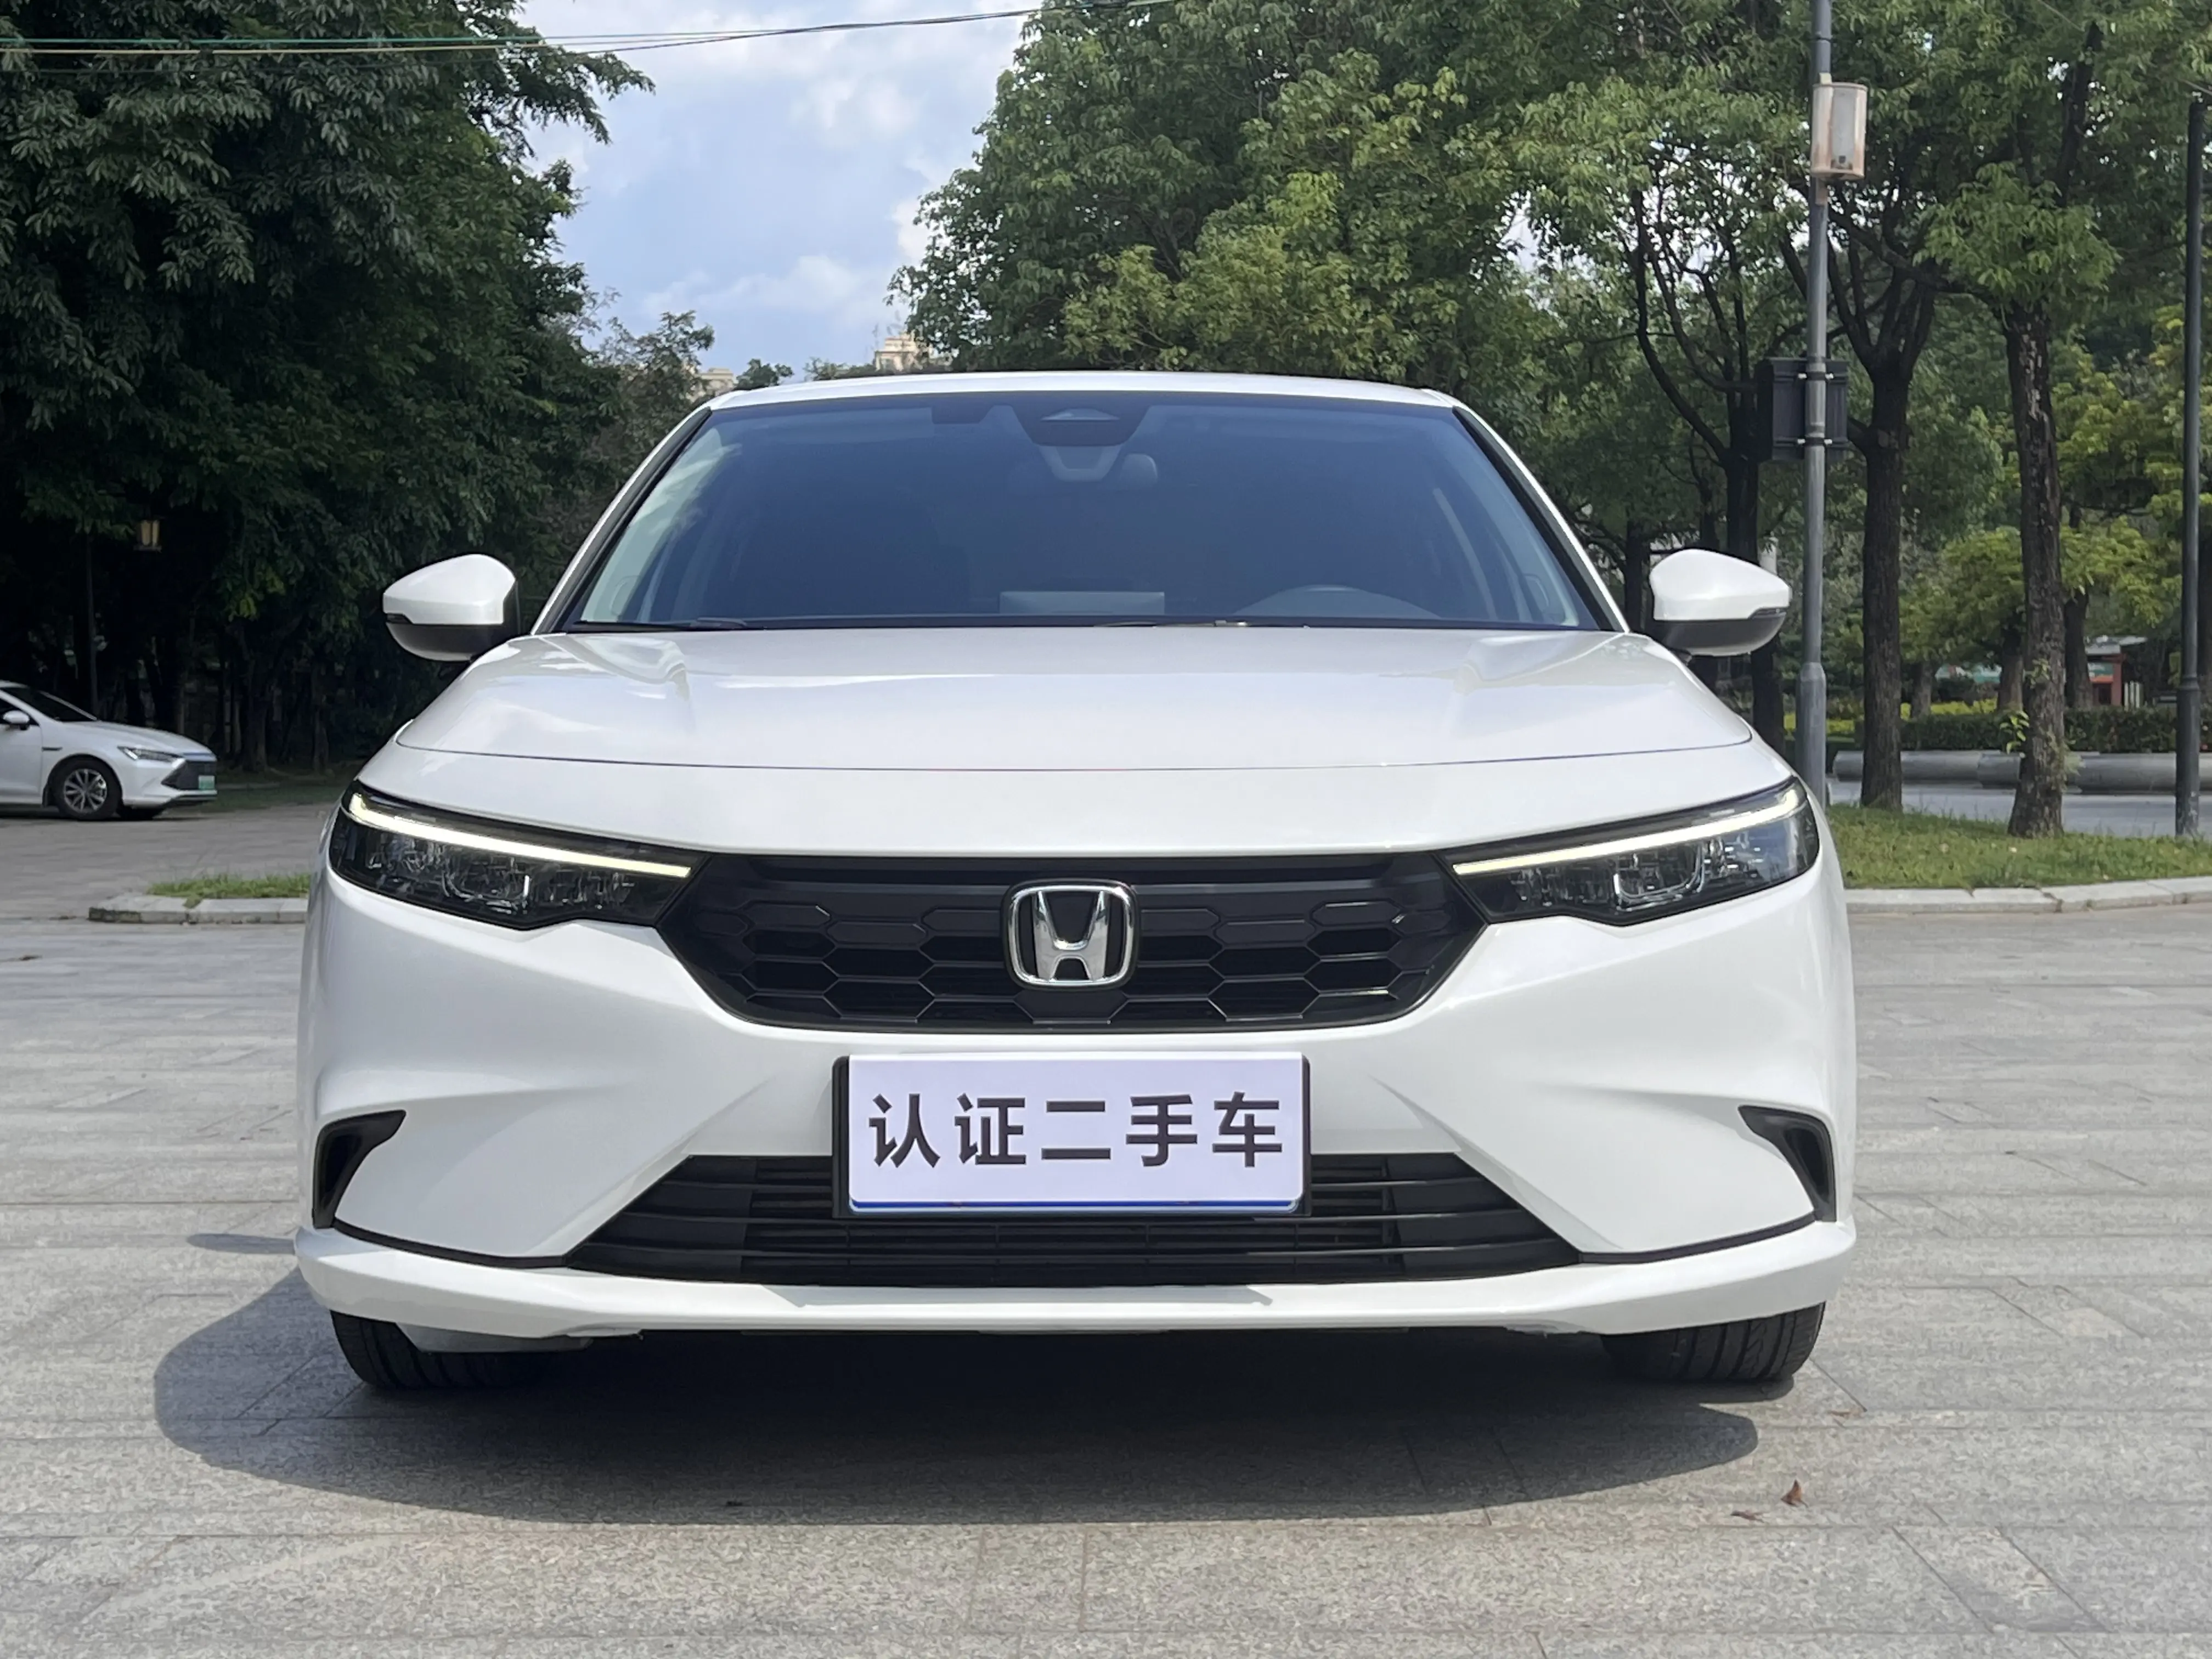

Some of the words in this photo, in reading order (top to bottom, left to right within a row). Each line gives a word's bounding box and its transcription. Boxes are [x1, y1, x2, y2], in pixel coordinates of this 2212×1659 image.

[868, 1092, 1283, 1168] 认证二手车
